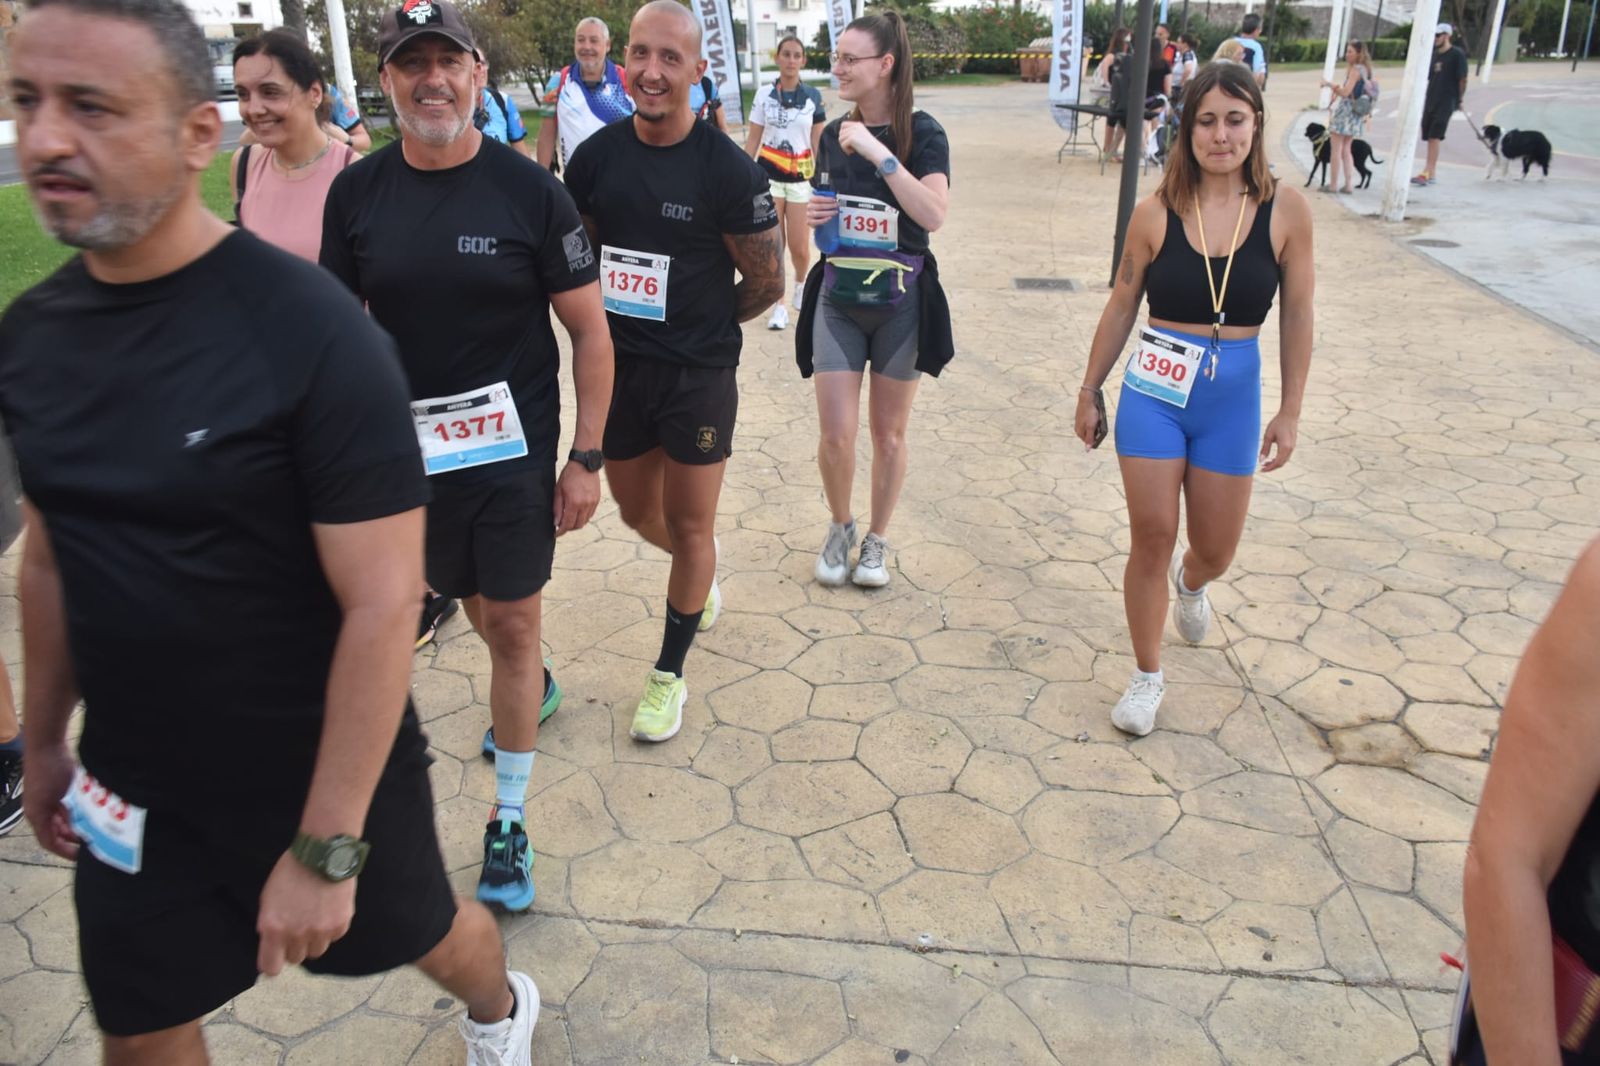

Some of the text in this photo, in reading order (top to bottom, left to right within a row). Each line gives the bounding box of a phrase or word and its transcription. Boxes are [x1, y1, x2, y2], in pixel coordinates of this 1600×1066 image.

[662, 202, 694, 222] GOC
[843, 214, 888, 234] 1391
[457, 235, 497, 255] GOC
[608, 270, 658, 296] 1376
[433, 411, 505, 442] 1377
